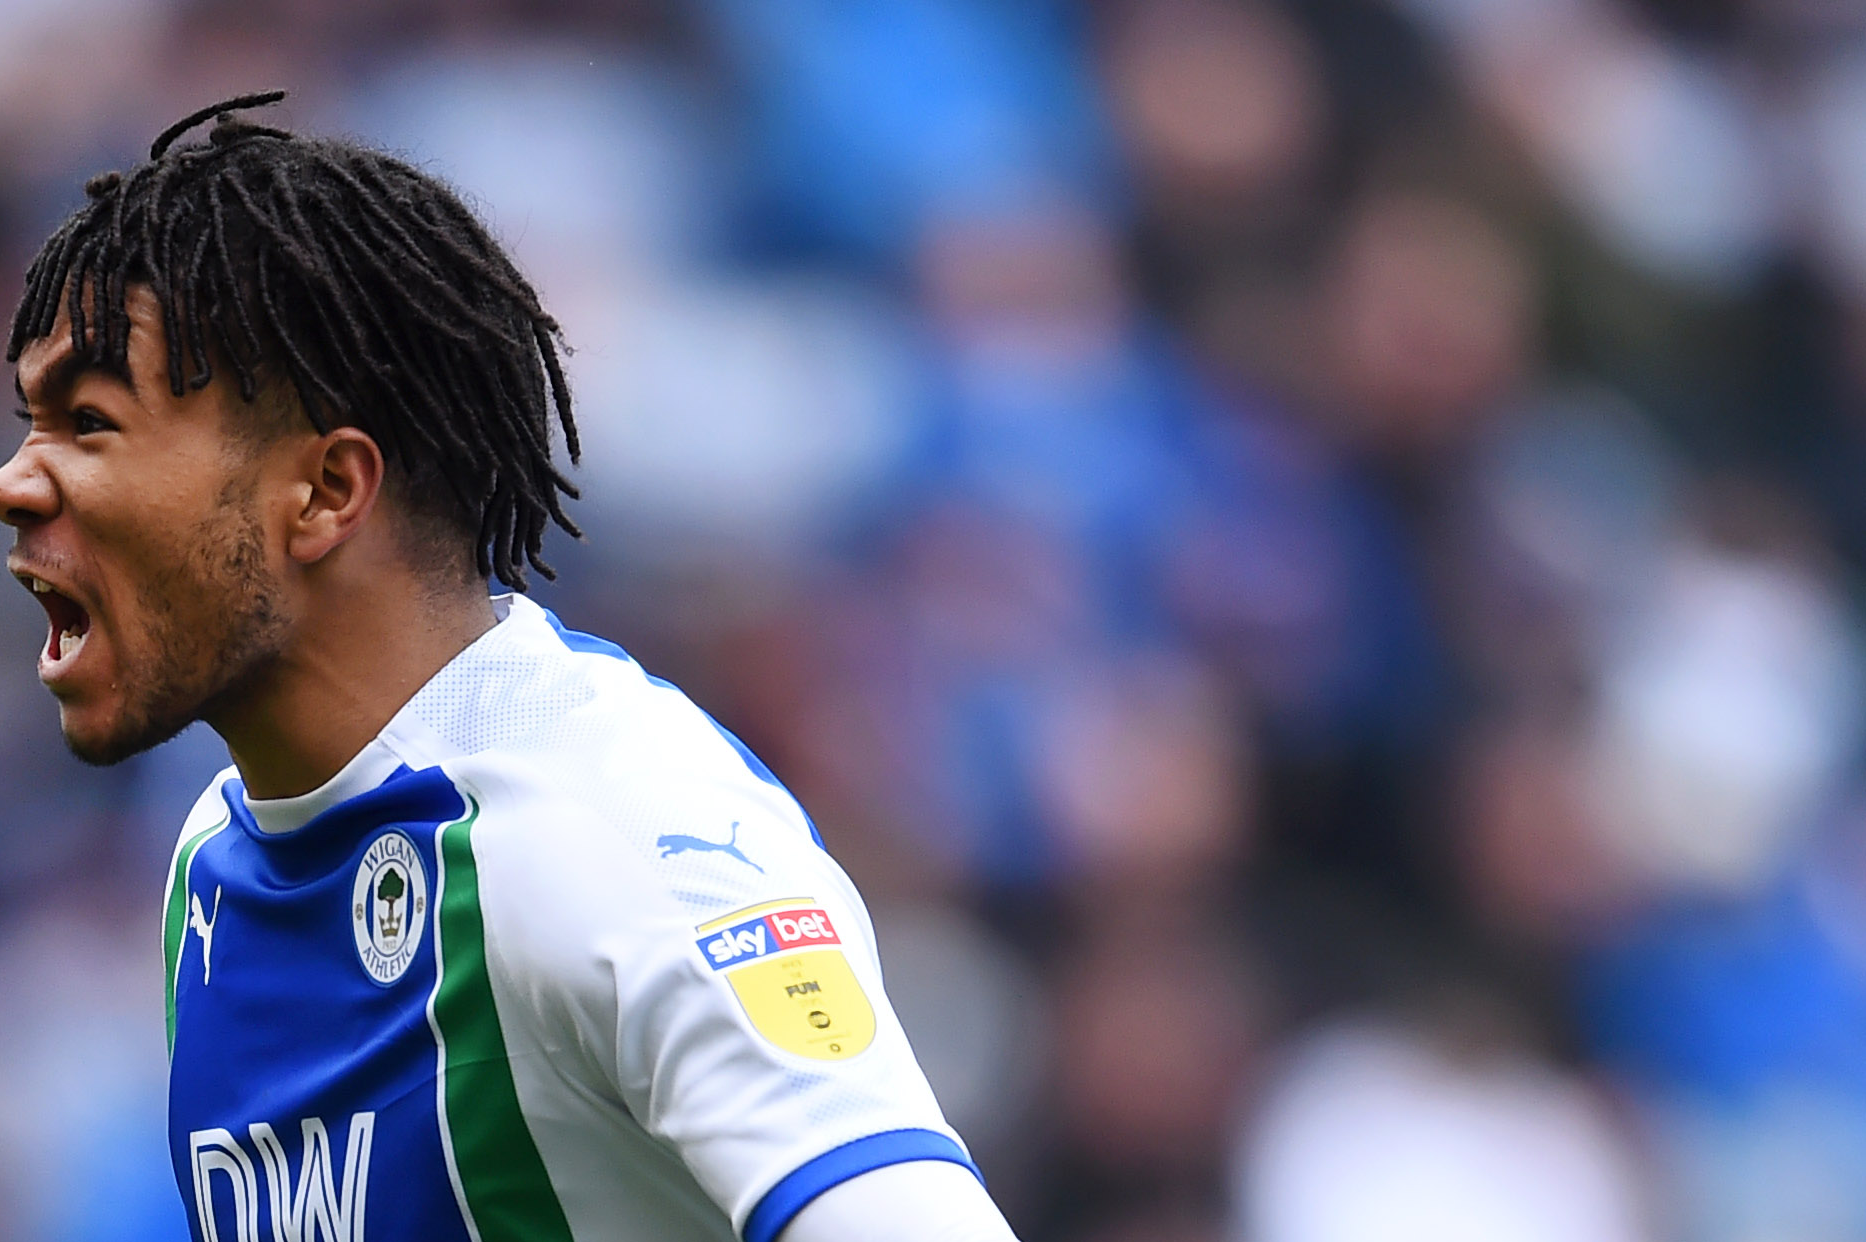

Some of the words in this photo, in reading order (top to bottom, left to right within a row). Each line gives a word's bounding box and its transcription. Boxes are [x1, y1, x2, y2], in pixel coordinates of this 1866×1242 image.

[364, 836, 415, 872] WIGAN
[707, 924, 767, 963] sky
[771, 912, 834, 942] bet
[363, 942, 414, 978] ATHLETIC
